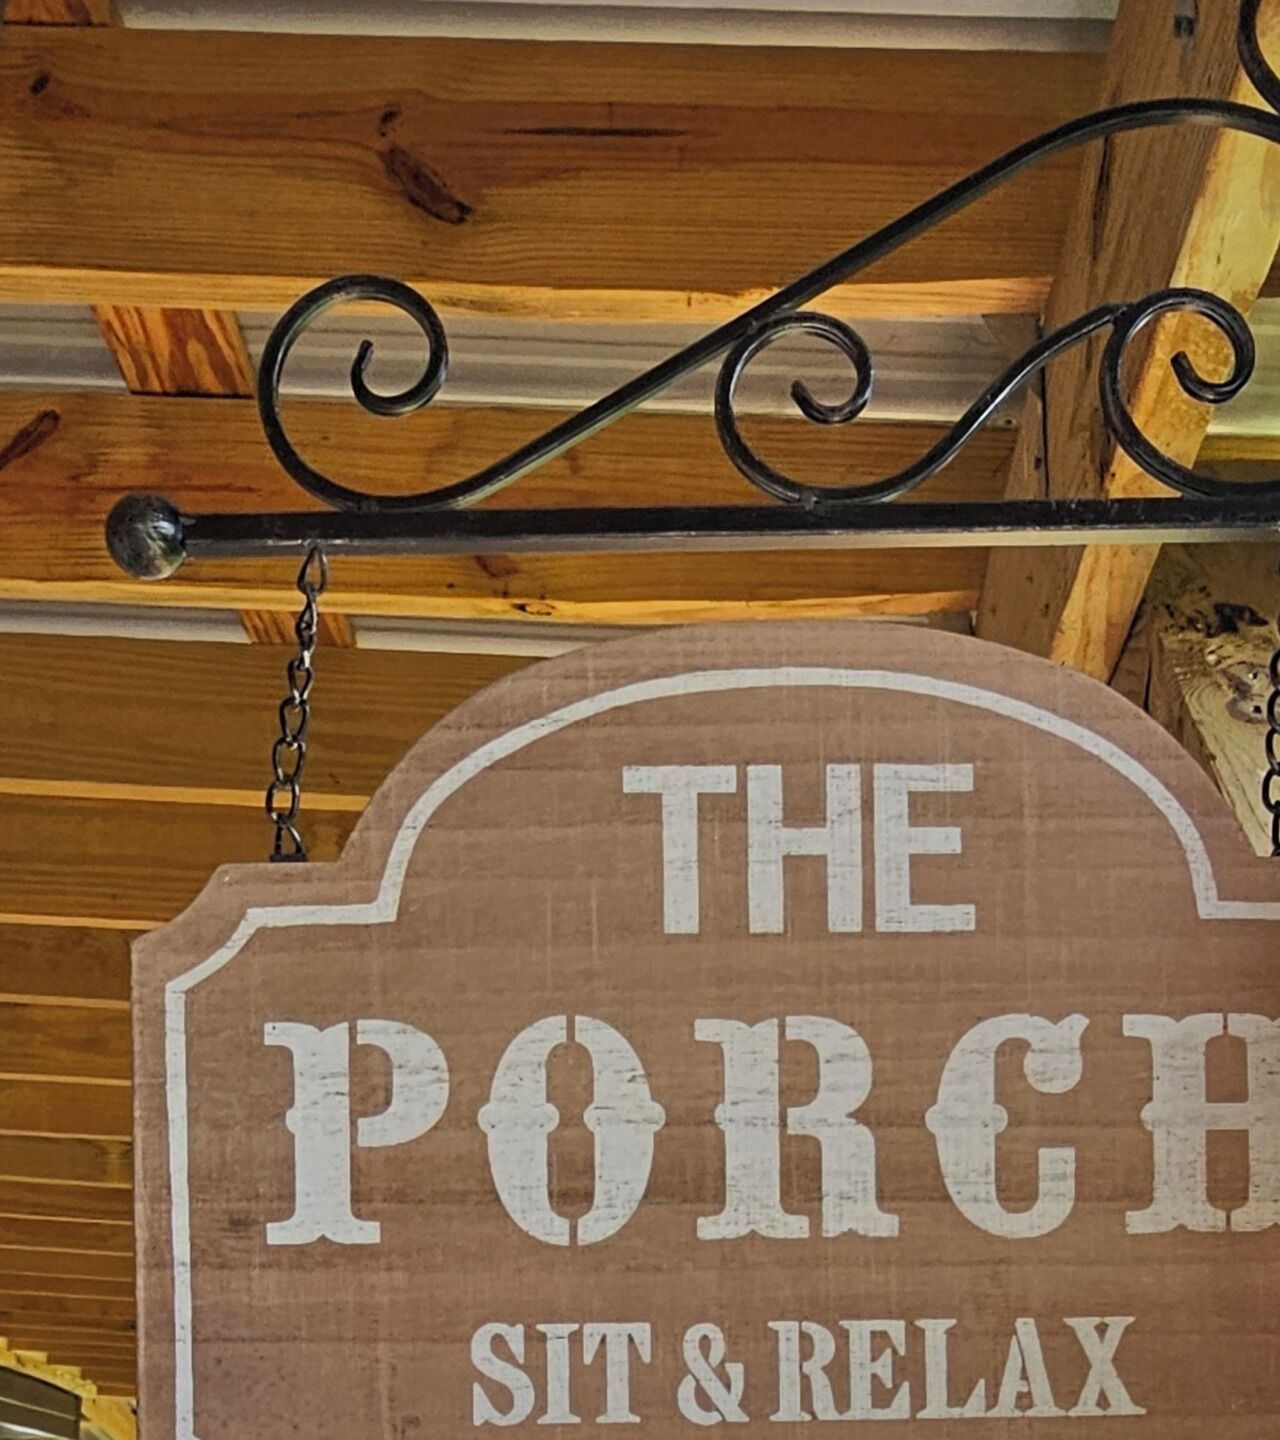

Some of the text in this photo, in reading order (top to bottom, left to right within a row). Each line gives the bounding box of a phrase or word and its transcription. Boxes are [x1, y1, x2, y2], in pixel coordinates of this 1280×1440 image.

[621, 762, 976, 934] THE
[470, 1316, 1147, 1427] SIT & RELAX
